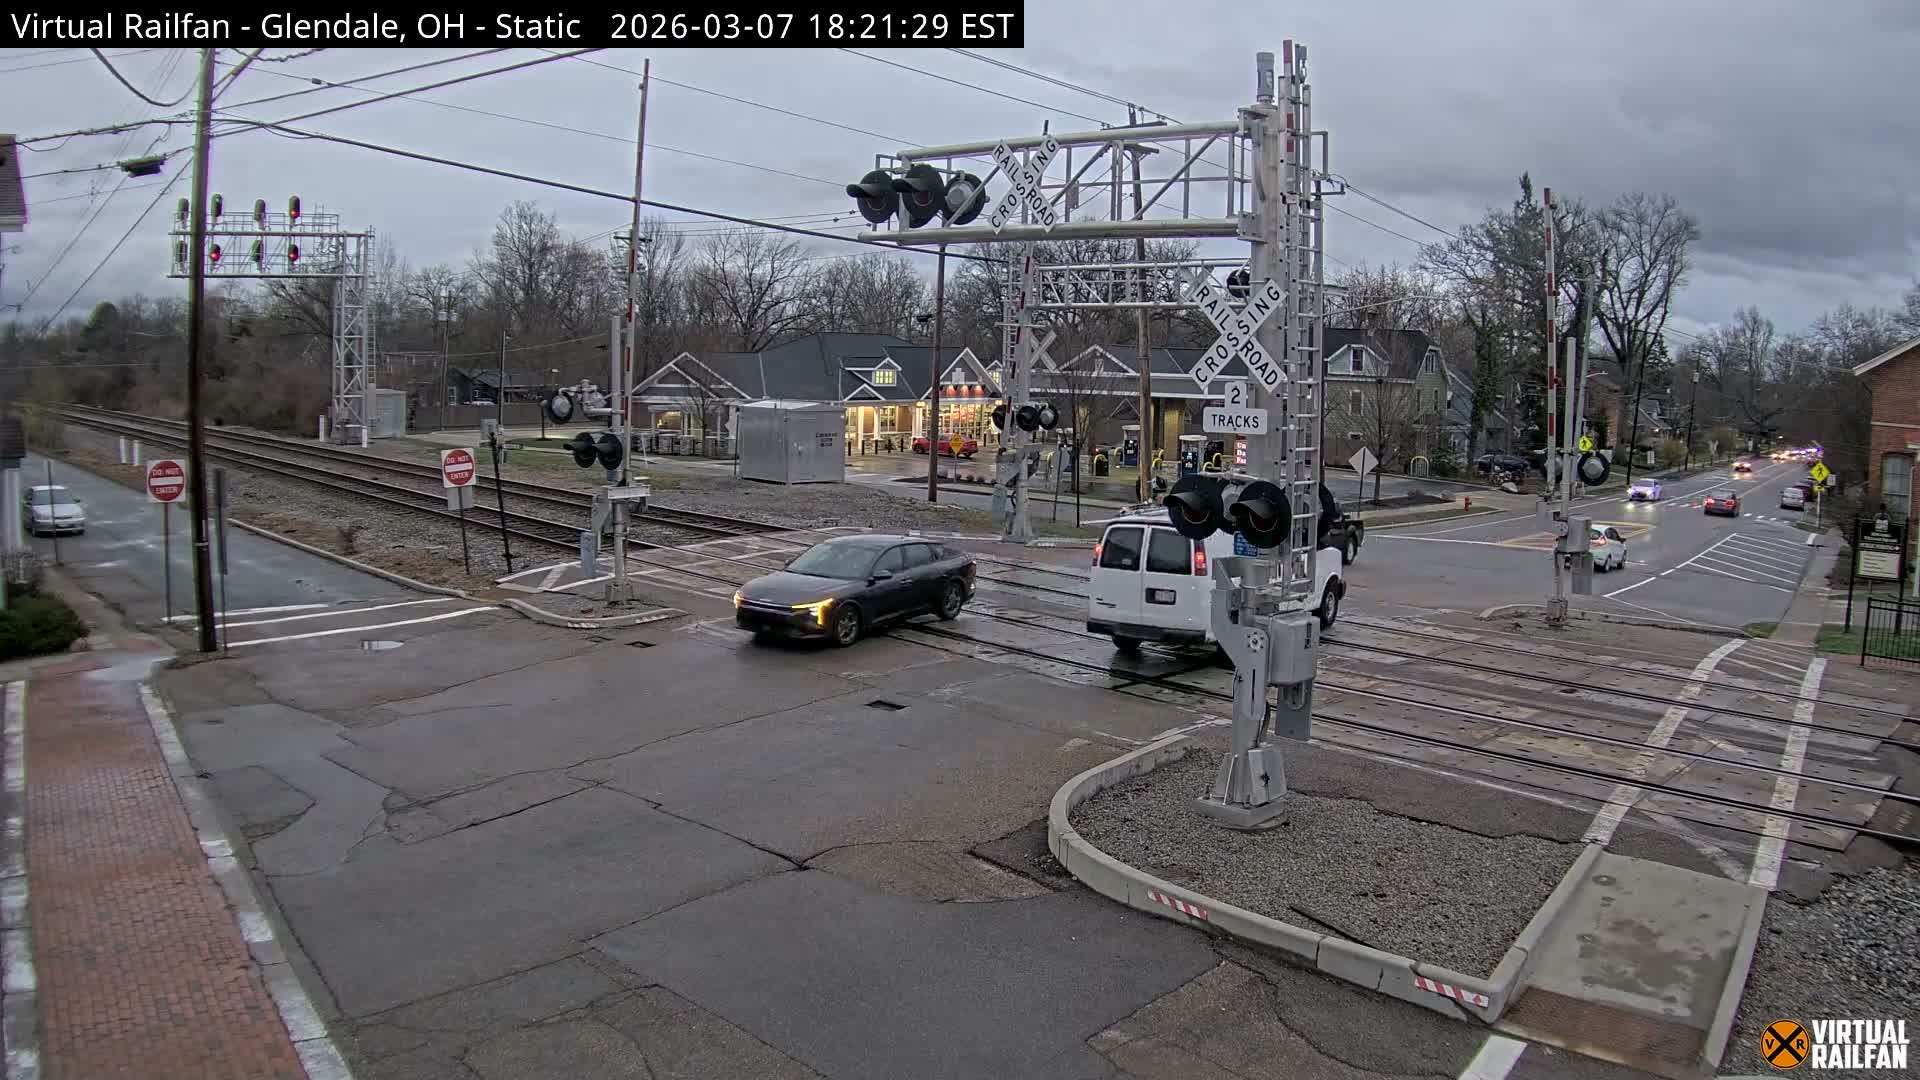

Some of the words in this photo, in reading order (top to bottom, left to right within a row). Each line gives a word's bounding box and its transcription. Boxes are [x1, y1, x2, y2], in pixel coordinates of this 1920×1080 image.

[991, 140, 1056, 228] CROSSING
[1195, 286, 1280, 383] CROSSING
[1231, 387, 1241, 404] 2
[1211, 414, 1260, 429] TRACKS
[450, 472, 469, 480] ENTER
[155, 486, 178, 495] ENTER
